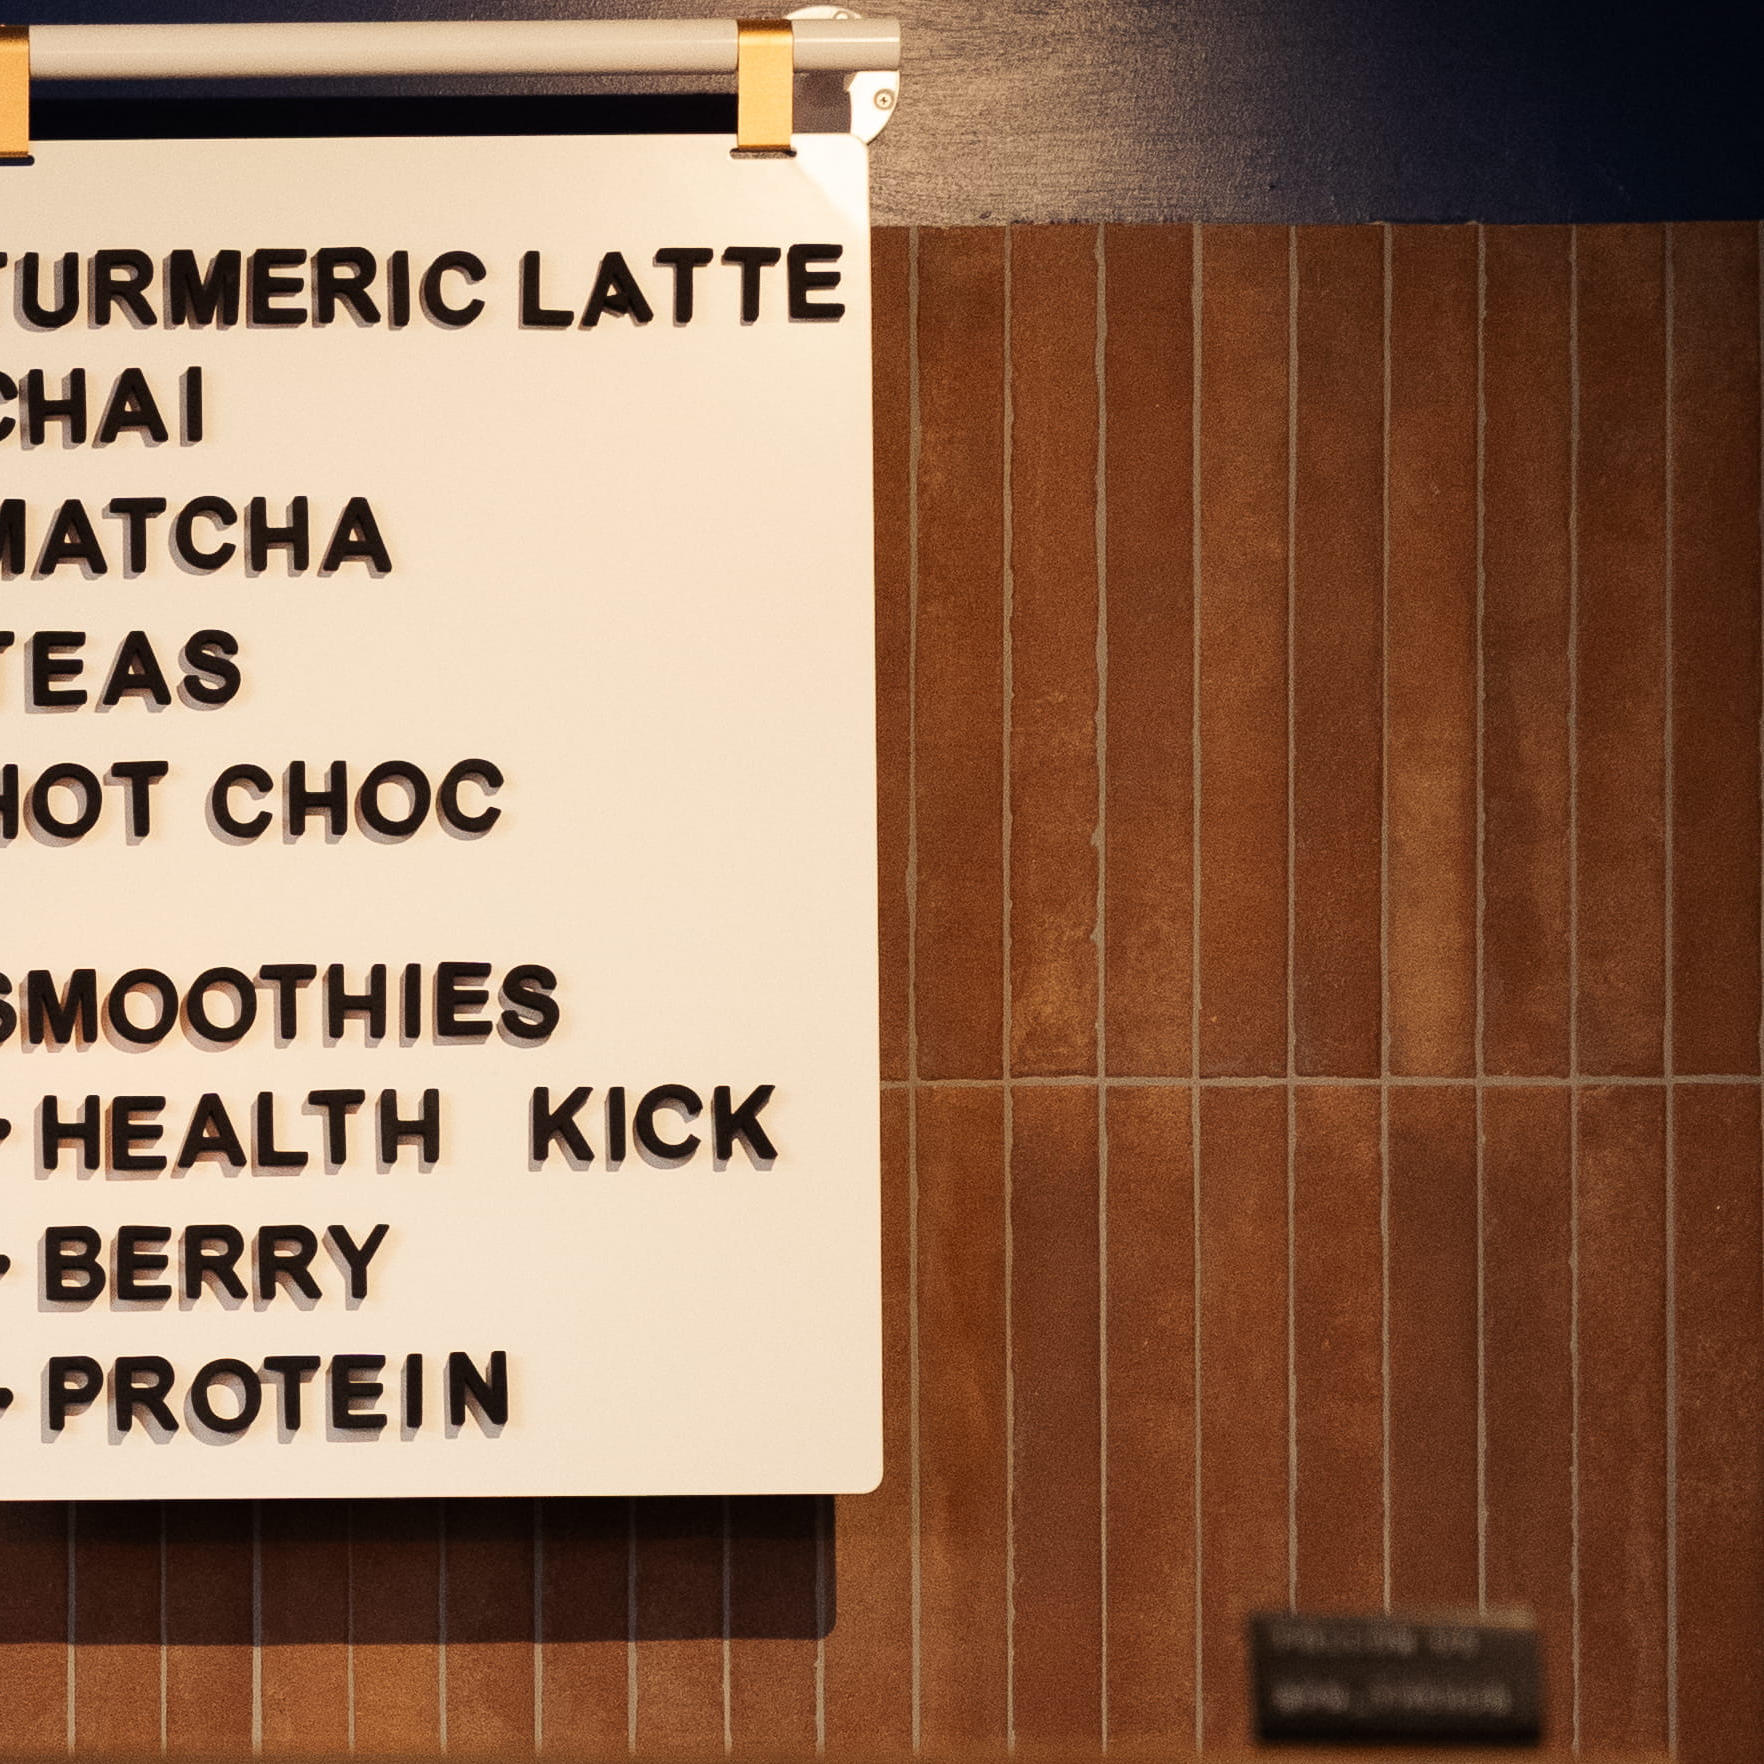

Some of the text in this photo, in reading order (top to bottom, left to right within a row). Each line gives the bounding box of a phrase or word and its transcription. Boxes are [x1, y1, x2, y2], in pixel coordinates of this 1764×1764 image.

[523, 244, 844, 326] LATTE
[212, 759, 503, 838] CHOC
[533, 1085, 777, 1161] KICK
